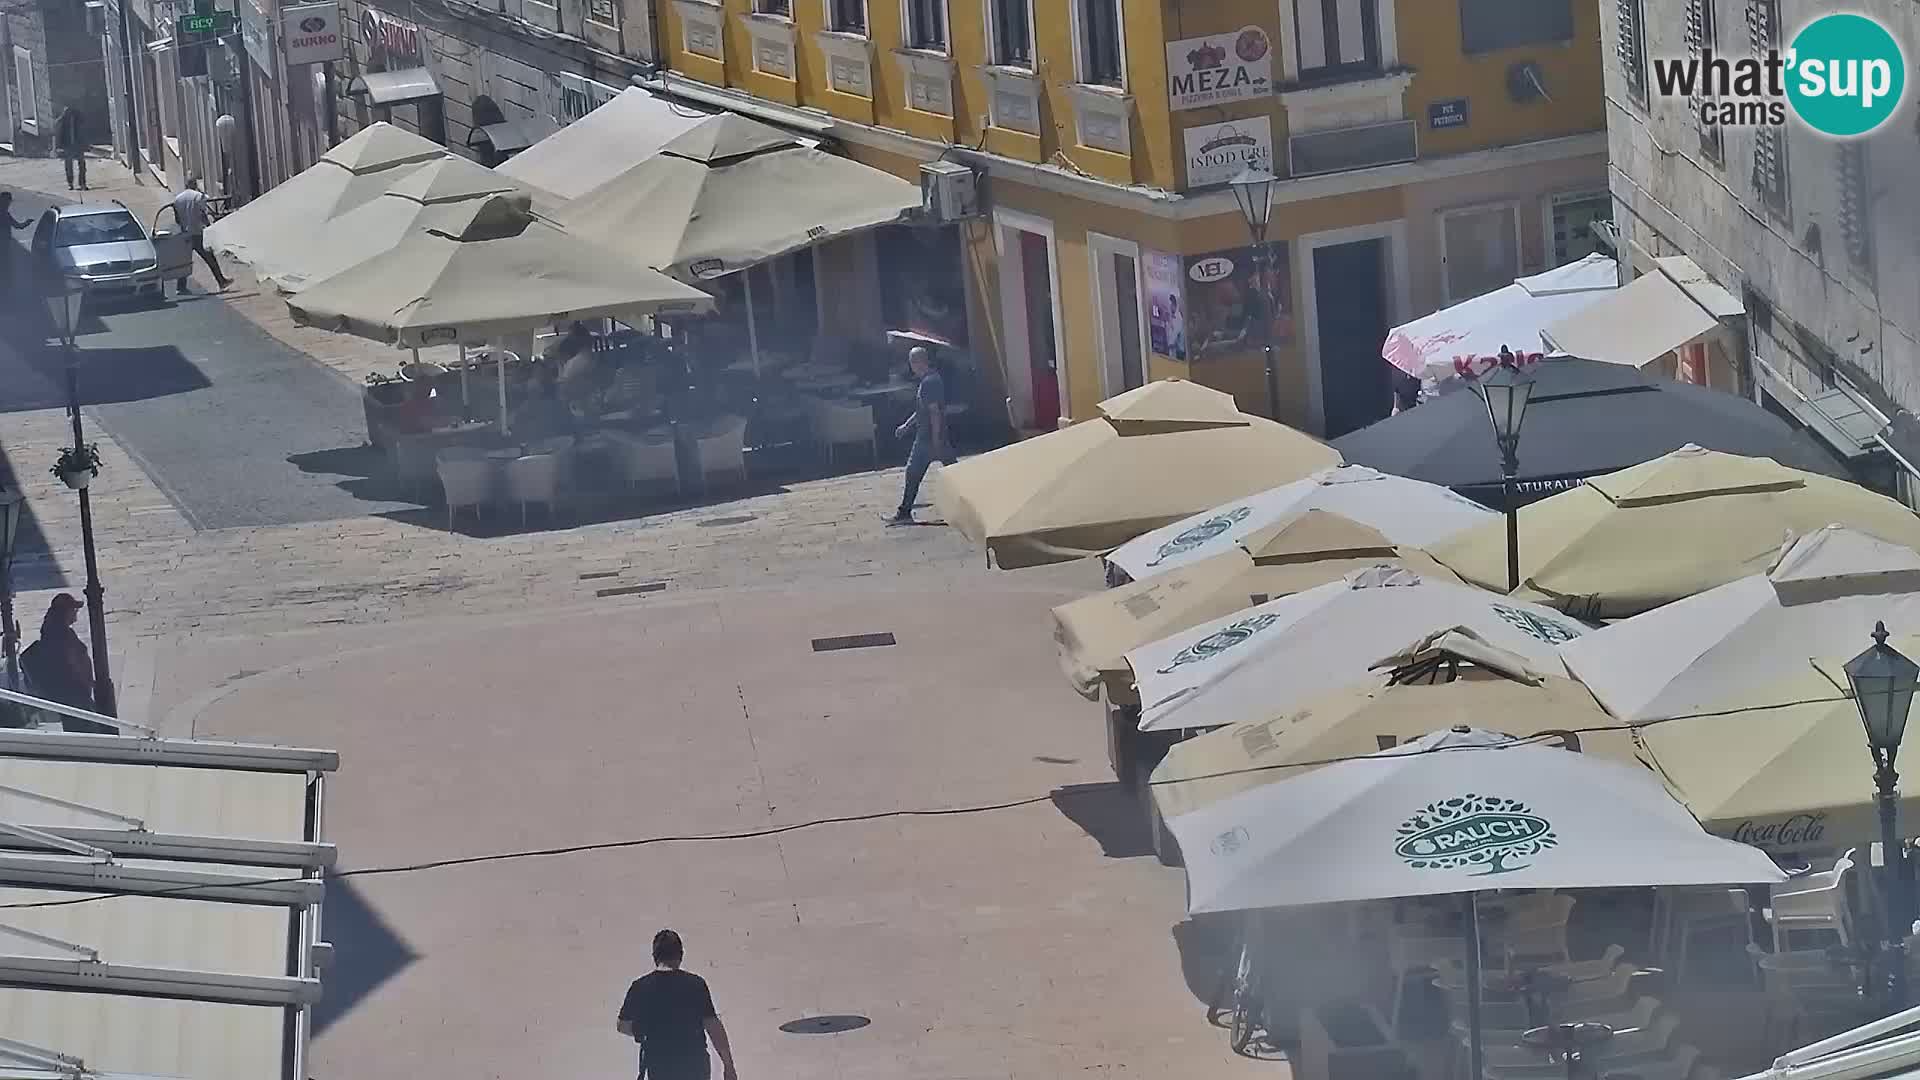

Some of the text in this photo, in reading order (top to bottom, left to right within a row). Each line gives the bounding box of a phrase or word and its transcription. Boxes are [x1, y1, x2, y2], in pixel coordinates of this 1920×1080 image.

[293, 34, 337, 48] SUKNO
[1172, 65, 1251, 97] MEZA
[1190, 151, 1236, 169] ISPOD
[1502, 479, 1570, 496] ATURAL
[1434, 818, 1534, 851] RAUCH
[1733, 813, 1825, 845] Coca-Cola
